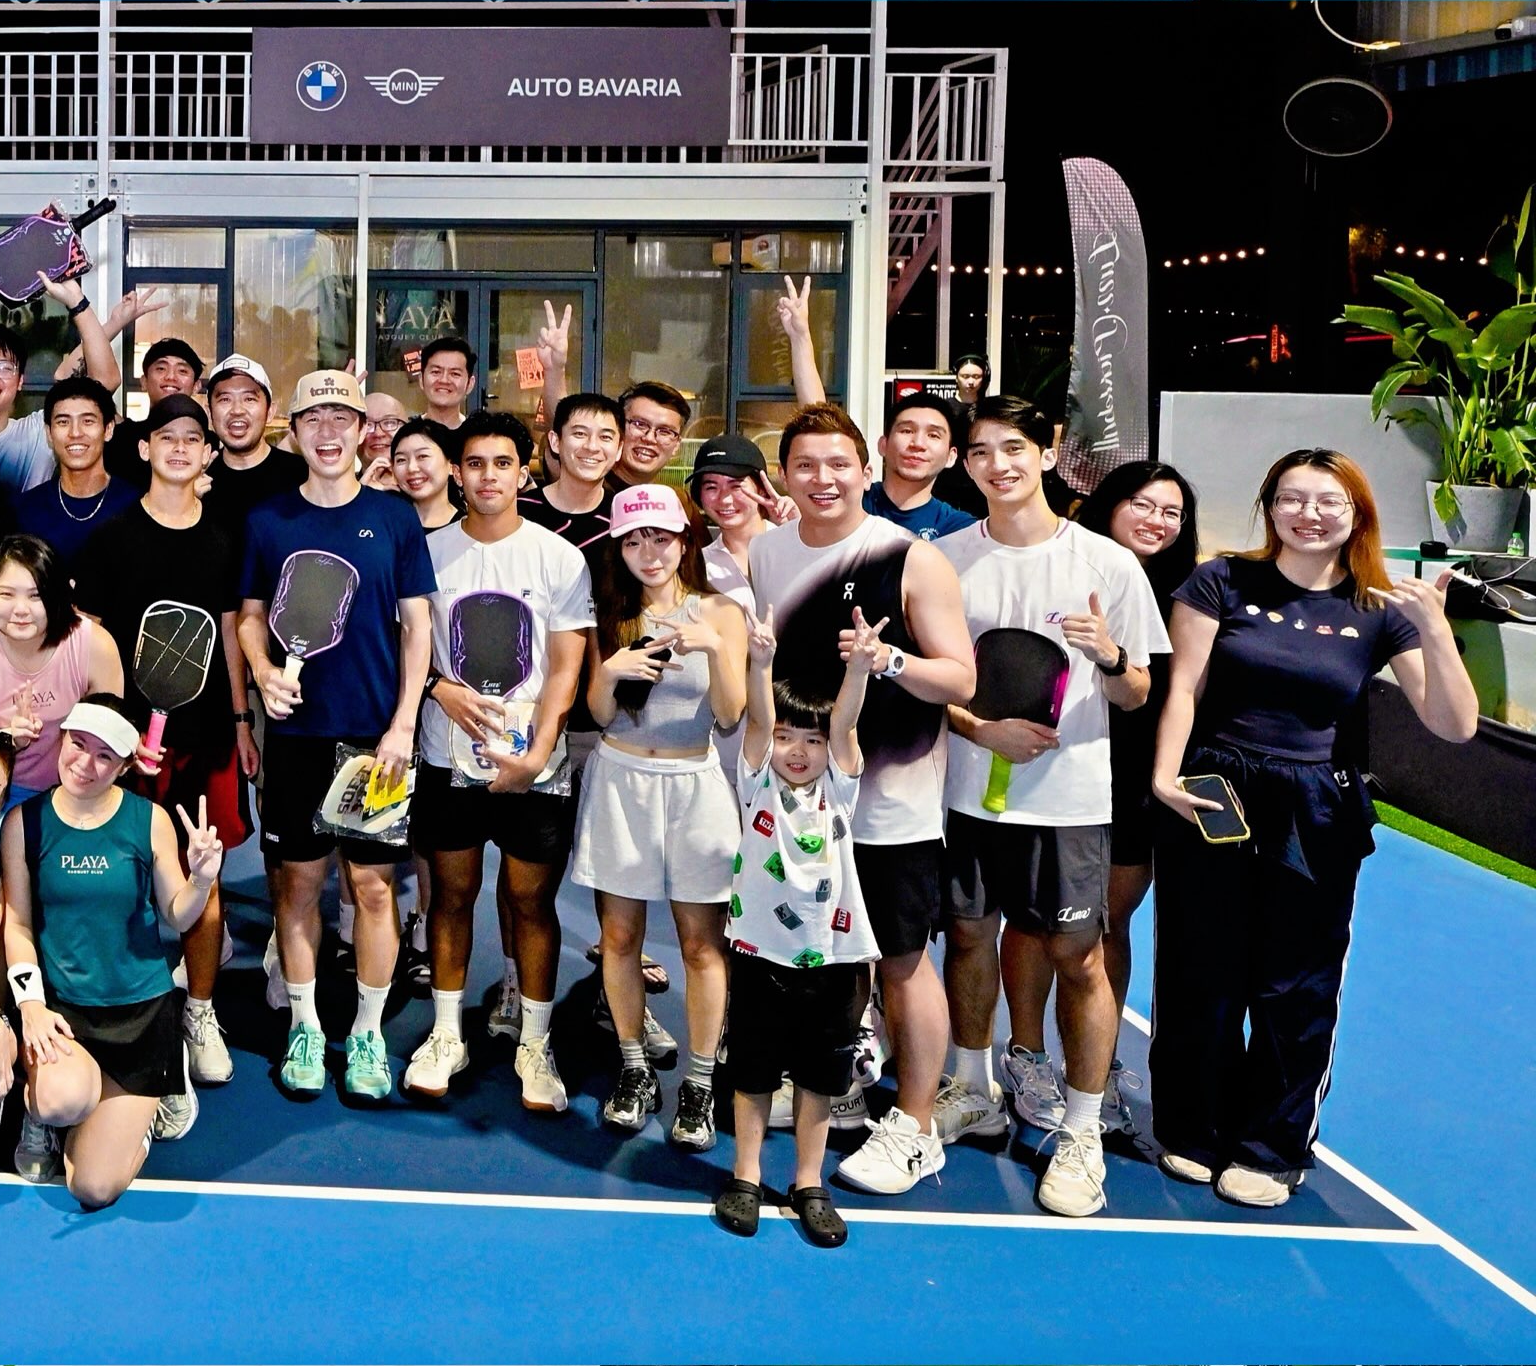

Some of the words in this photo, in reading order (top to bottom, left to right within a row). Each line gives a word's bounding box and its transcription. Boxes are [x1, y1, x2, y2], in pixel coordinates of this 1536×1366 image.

[390, 81, 419, 92] MINI
[507, 78, 572, 97] AUTO
[577, 78, 683, 97] BAVARIA
[310, 386, 349, 398] tama
[624, 500, 667, 514] tama
[60, 855, 110, 870] PLAYA
